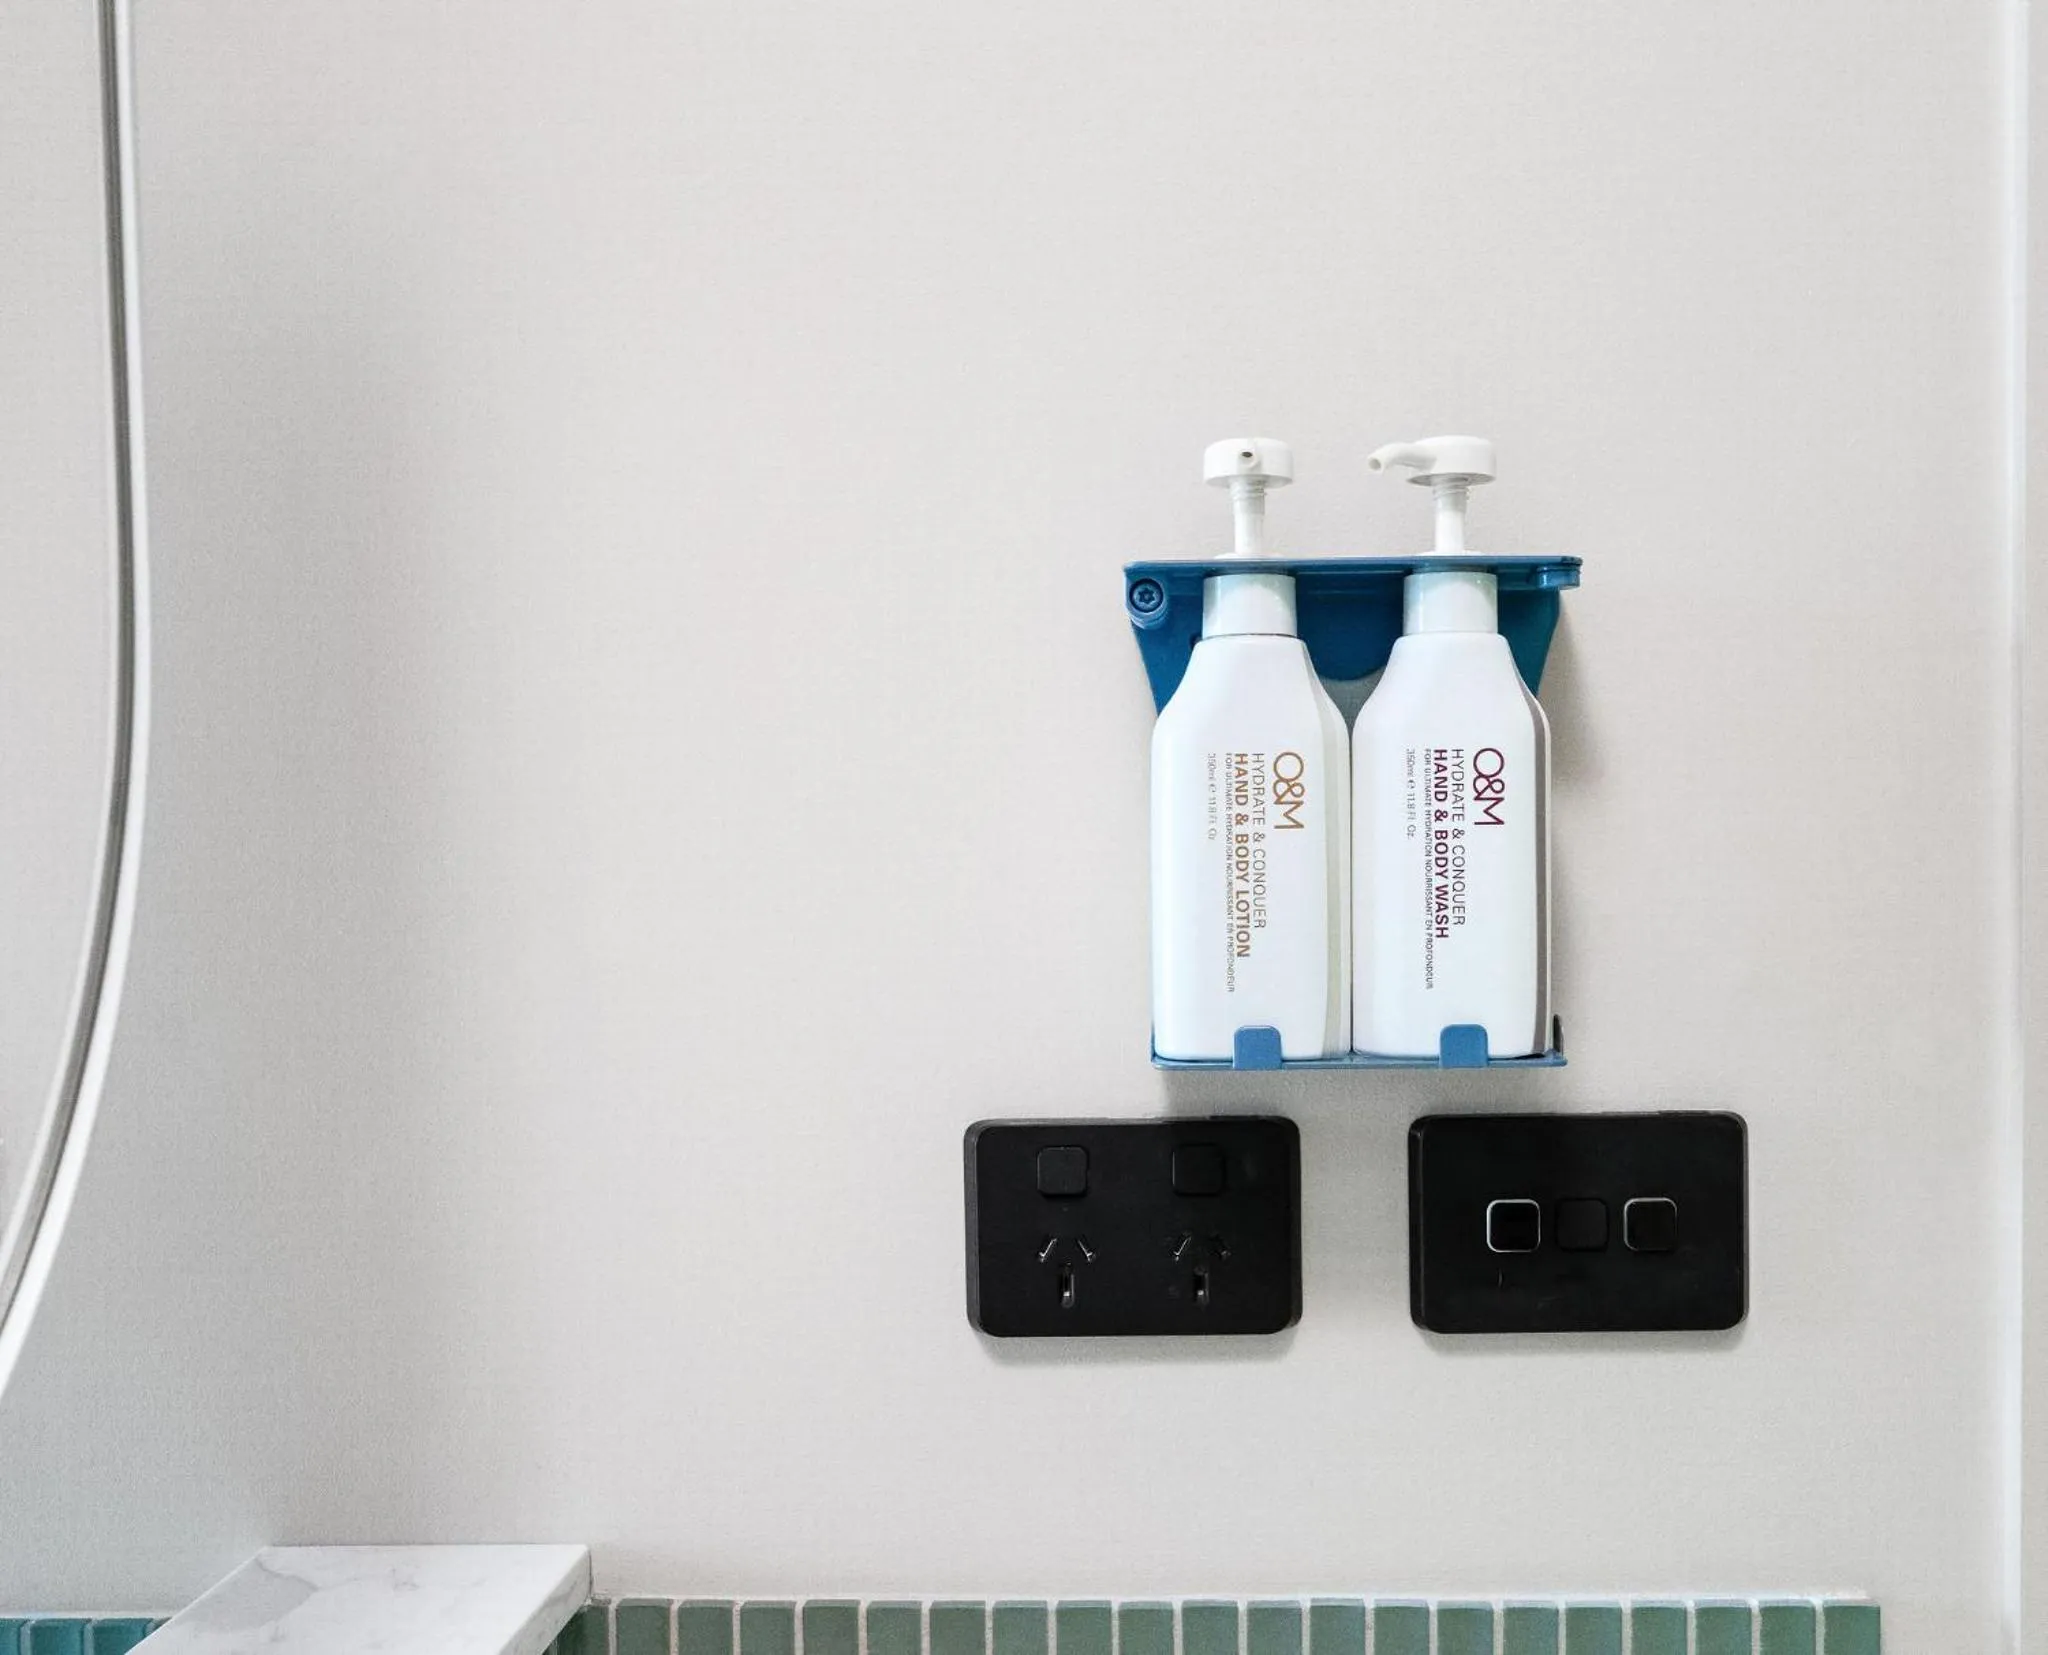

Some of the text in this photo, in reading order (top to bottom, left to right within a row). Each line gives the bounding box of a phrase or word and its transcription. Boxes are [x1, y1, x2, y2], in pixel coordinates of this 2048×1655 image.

[1273, 752, 1305, 829] O&M
[1424, 748, 1432, 765] FOR
[1424, 768, 1432, 806] ULTIMATE
[1473, 748, 1505, 825] O&M
[1235, 753, 1250, 958] HAND & BODY LOTION
[1252, 753, 1267, 929] HYDRATE & CONQUER
[1424, 809, 1432, 857] HYDRATION
[1434, 749, 1449, 939] HAND & BODY WASH
[1451, 749, 1466, 926] HYDRATE & CONQUER
[1425, 859, 1433, 917] NOURRISSANT
[1425, 920, 1433, 930] EN
